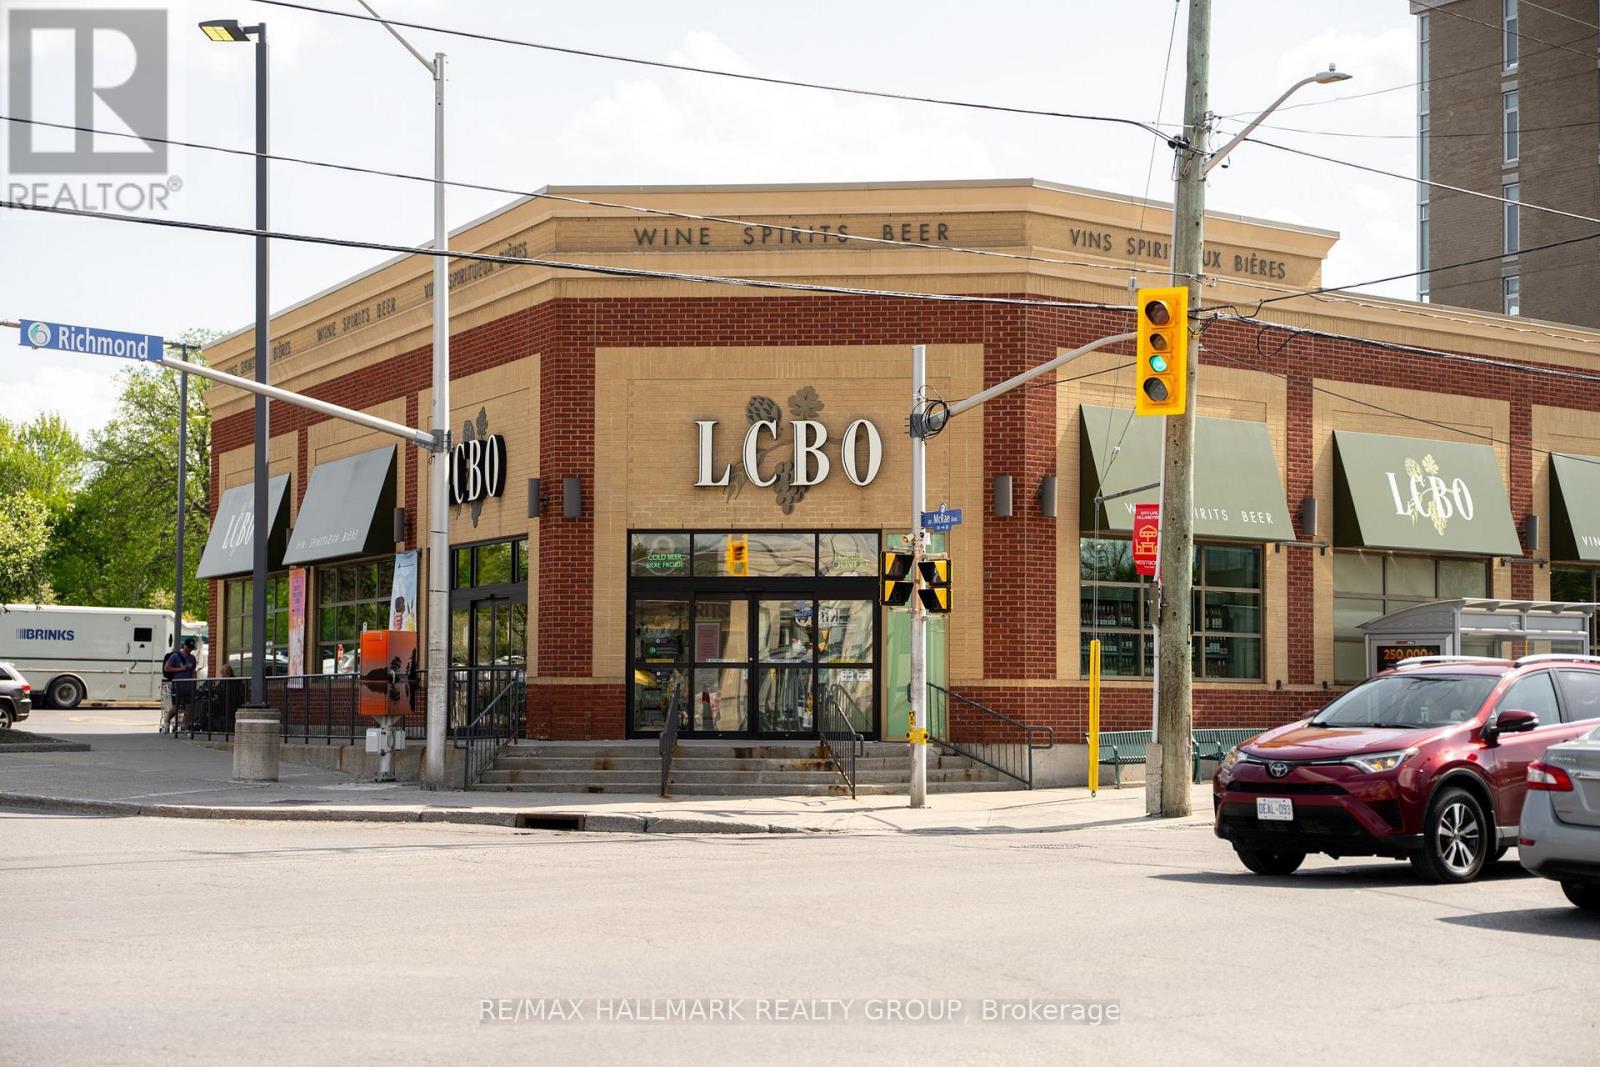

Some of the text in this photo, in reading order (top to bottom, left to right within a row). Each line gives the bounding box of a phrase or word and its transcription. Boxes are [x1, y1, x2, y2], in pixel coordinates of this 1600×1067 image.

[634, 222, 949, 246] WINE SPIRITS BEER
[1069, 228, 1286, 280] VINS SPIRIUX BIÈRES
[58, 326, 149, 359] Richmond
[450, 434, 507, 505] CBO
[693, 418, 883, 488] LCBO
[1194, 507, 1275, 525] IRITS BEER
[1385, 471, 1475, 521] LCBO
[26, 628, 75, 641] BRINKS
